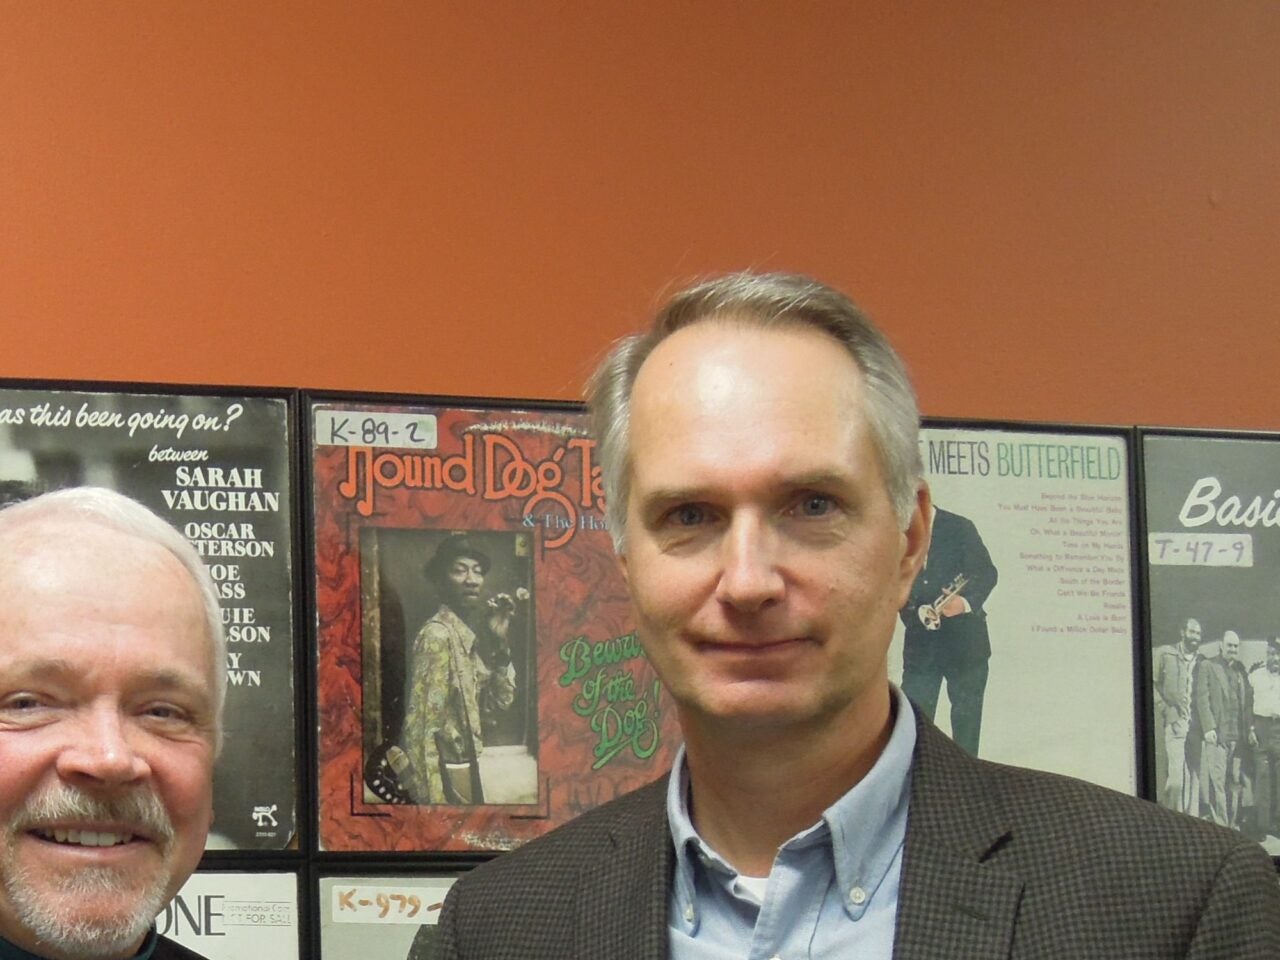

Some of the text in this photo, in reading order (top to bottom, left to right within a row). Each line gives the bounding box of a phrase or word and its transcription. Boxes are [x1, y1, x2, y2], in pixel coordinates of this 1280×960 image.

[29, 402, 72, 428] this
[75, 402, 126, 428] been
[127, 408, 189, 439] going
[192, 403, 244, 432] on?
[330, 416, 426, 445] K-89-2
[148, 444, 209, 462] between
[928, 440, 1121, 481] MEETS BUTTERFIELD
[175, 466, 263, 488] SARAH
[161, 490, 280, 512] VAUGHAN
[184, 522, 256, 540] OSCAR
[1154, 538, 1246, 563] T-47-9
